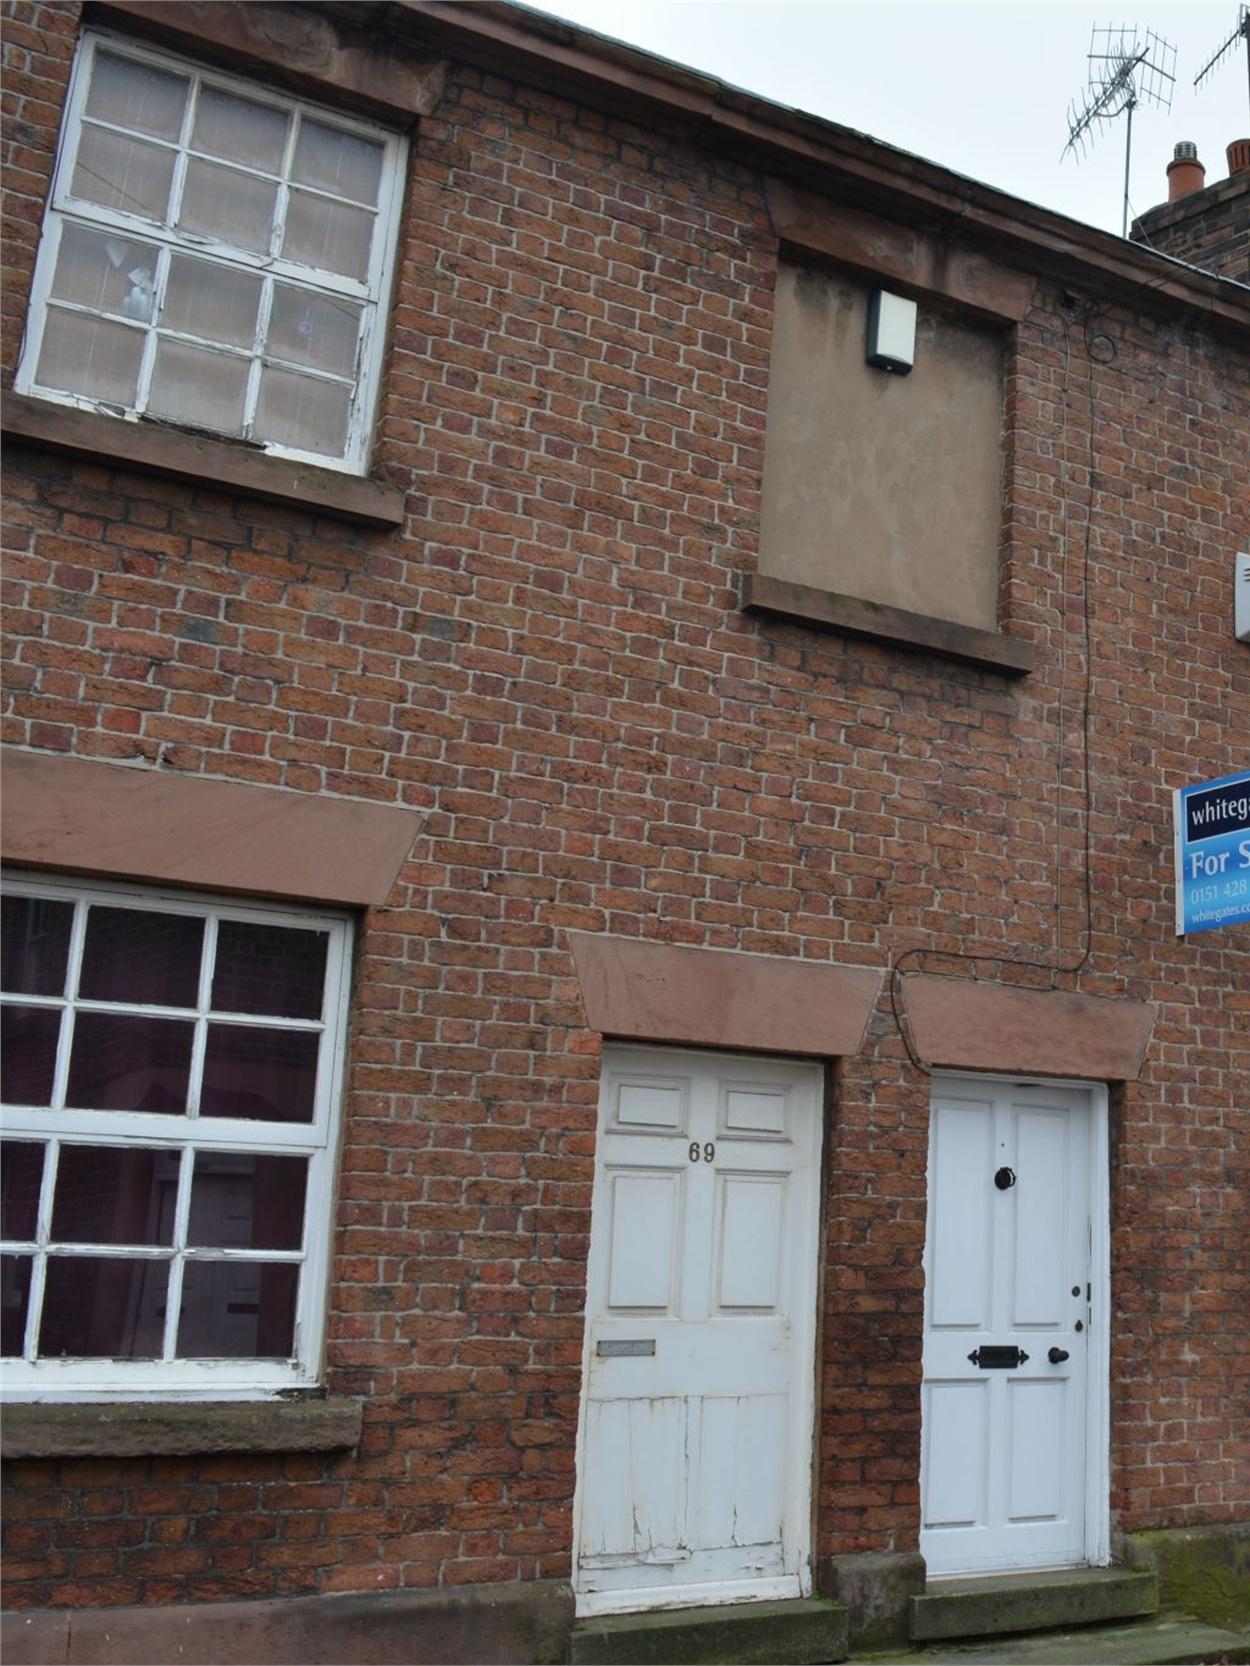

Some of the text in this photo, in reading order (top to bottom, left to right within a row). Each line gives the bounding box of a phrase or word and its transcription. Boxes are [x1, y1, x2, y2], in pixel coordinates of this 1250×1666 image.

[1189, 851, 1231, 880] For
[1190, 886, 1220, 905] 0151
[1223, 879, 1248, 898] 428
[688, 1141, 716, 1164] 69
